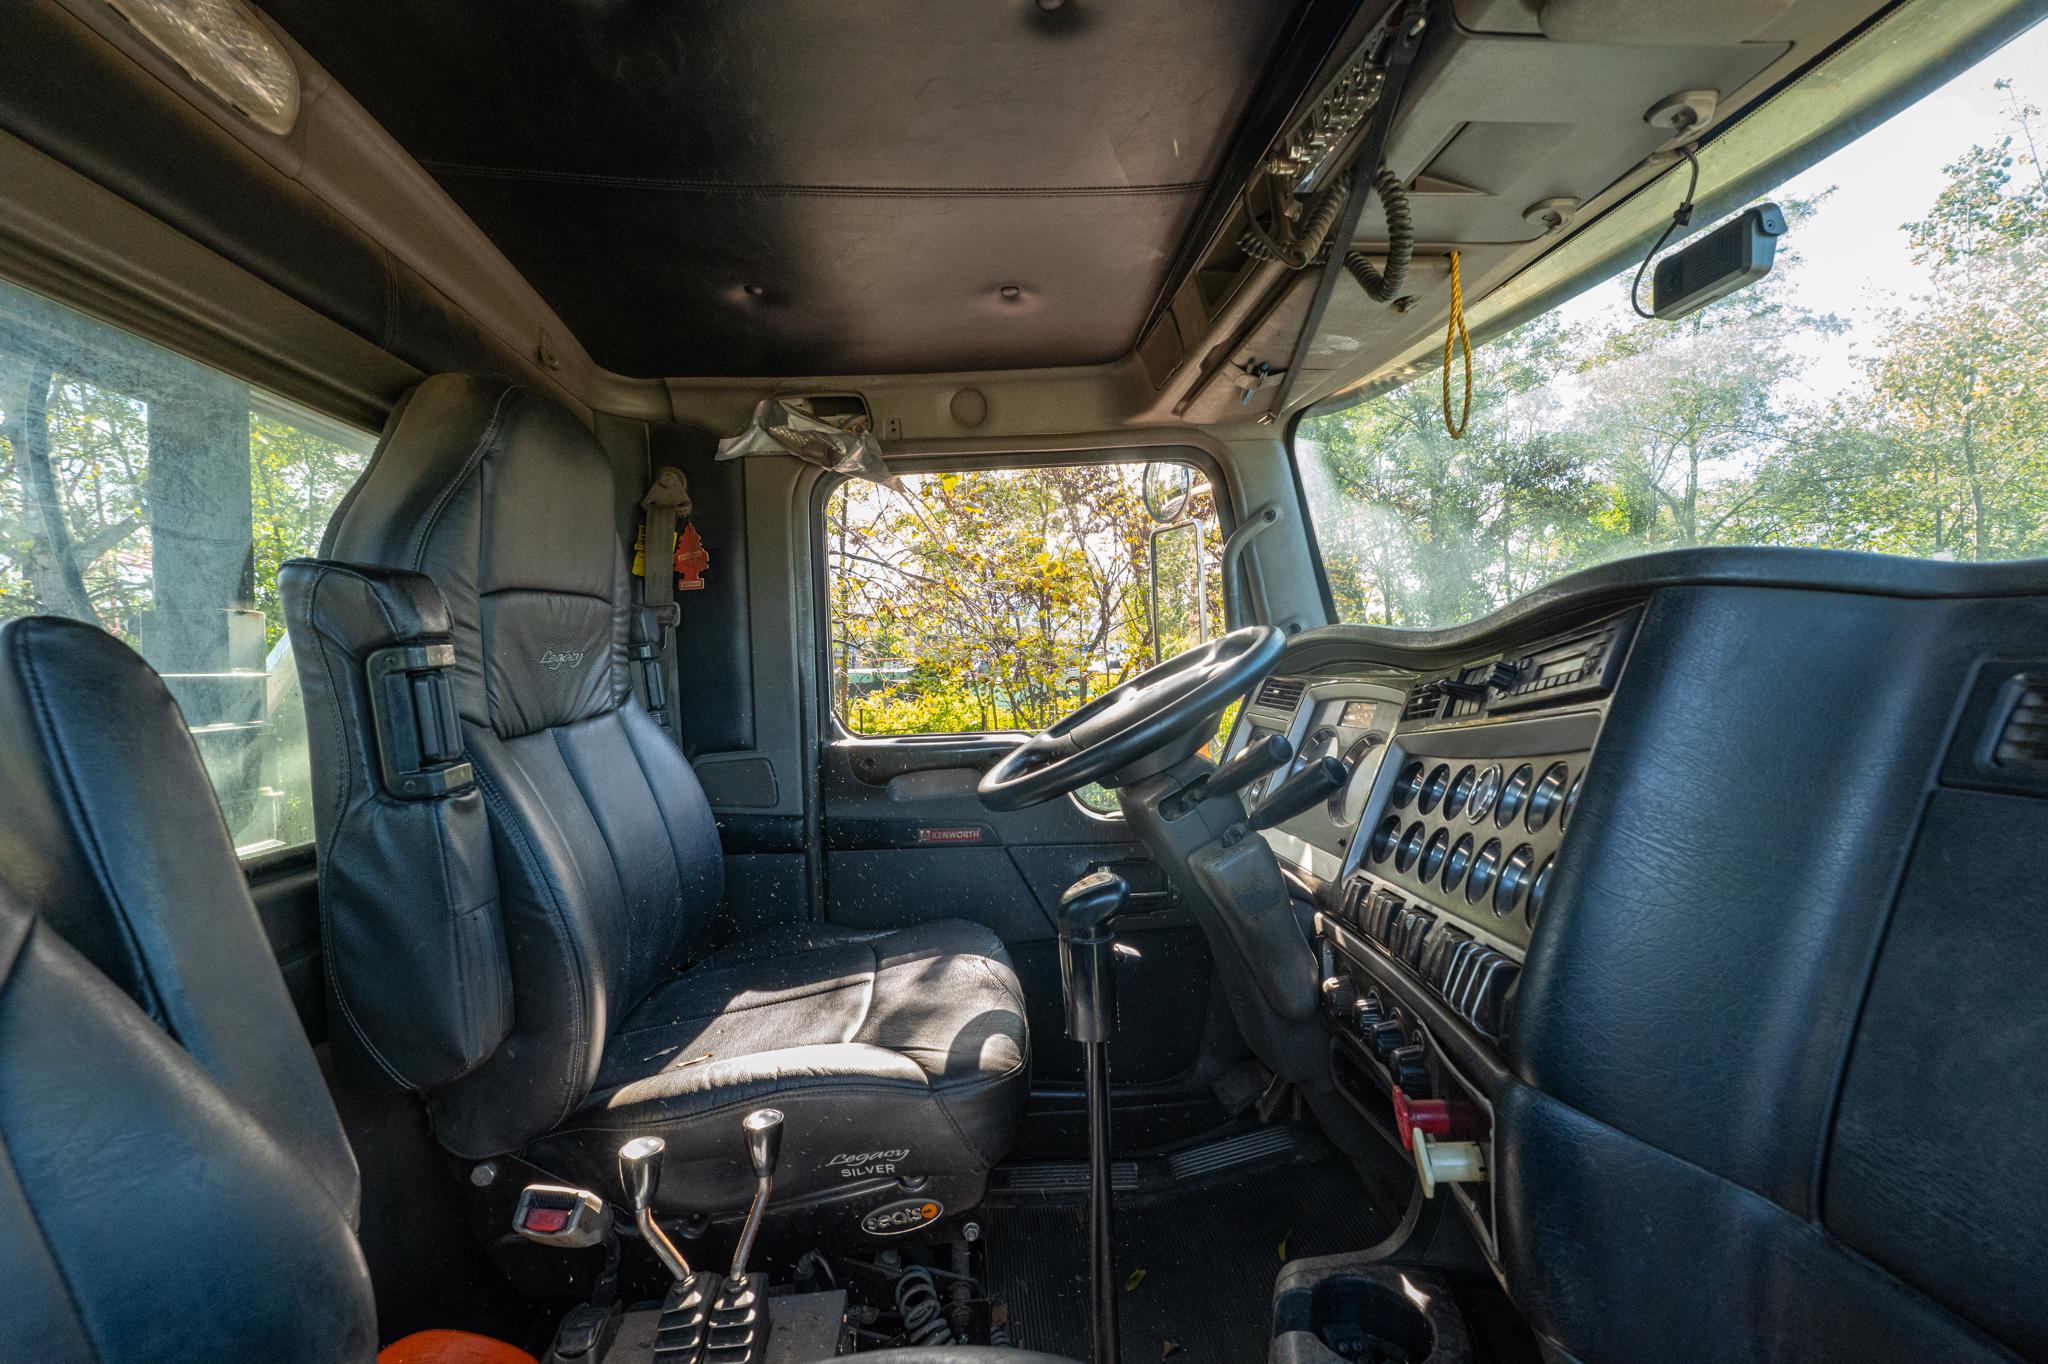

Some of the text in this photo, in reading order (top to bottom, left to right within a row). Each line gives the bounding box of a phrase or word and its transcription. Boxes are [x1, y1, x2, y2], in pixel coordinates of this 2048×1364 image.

[540, 651, 584, 669] Legacy
[931, 830, 980, 839] KENWORTH
[825, 1149, 910, 1167] Legacy
[841, 1164, 896, 1177] SILVER
